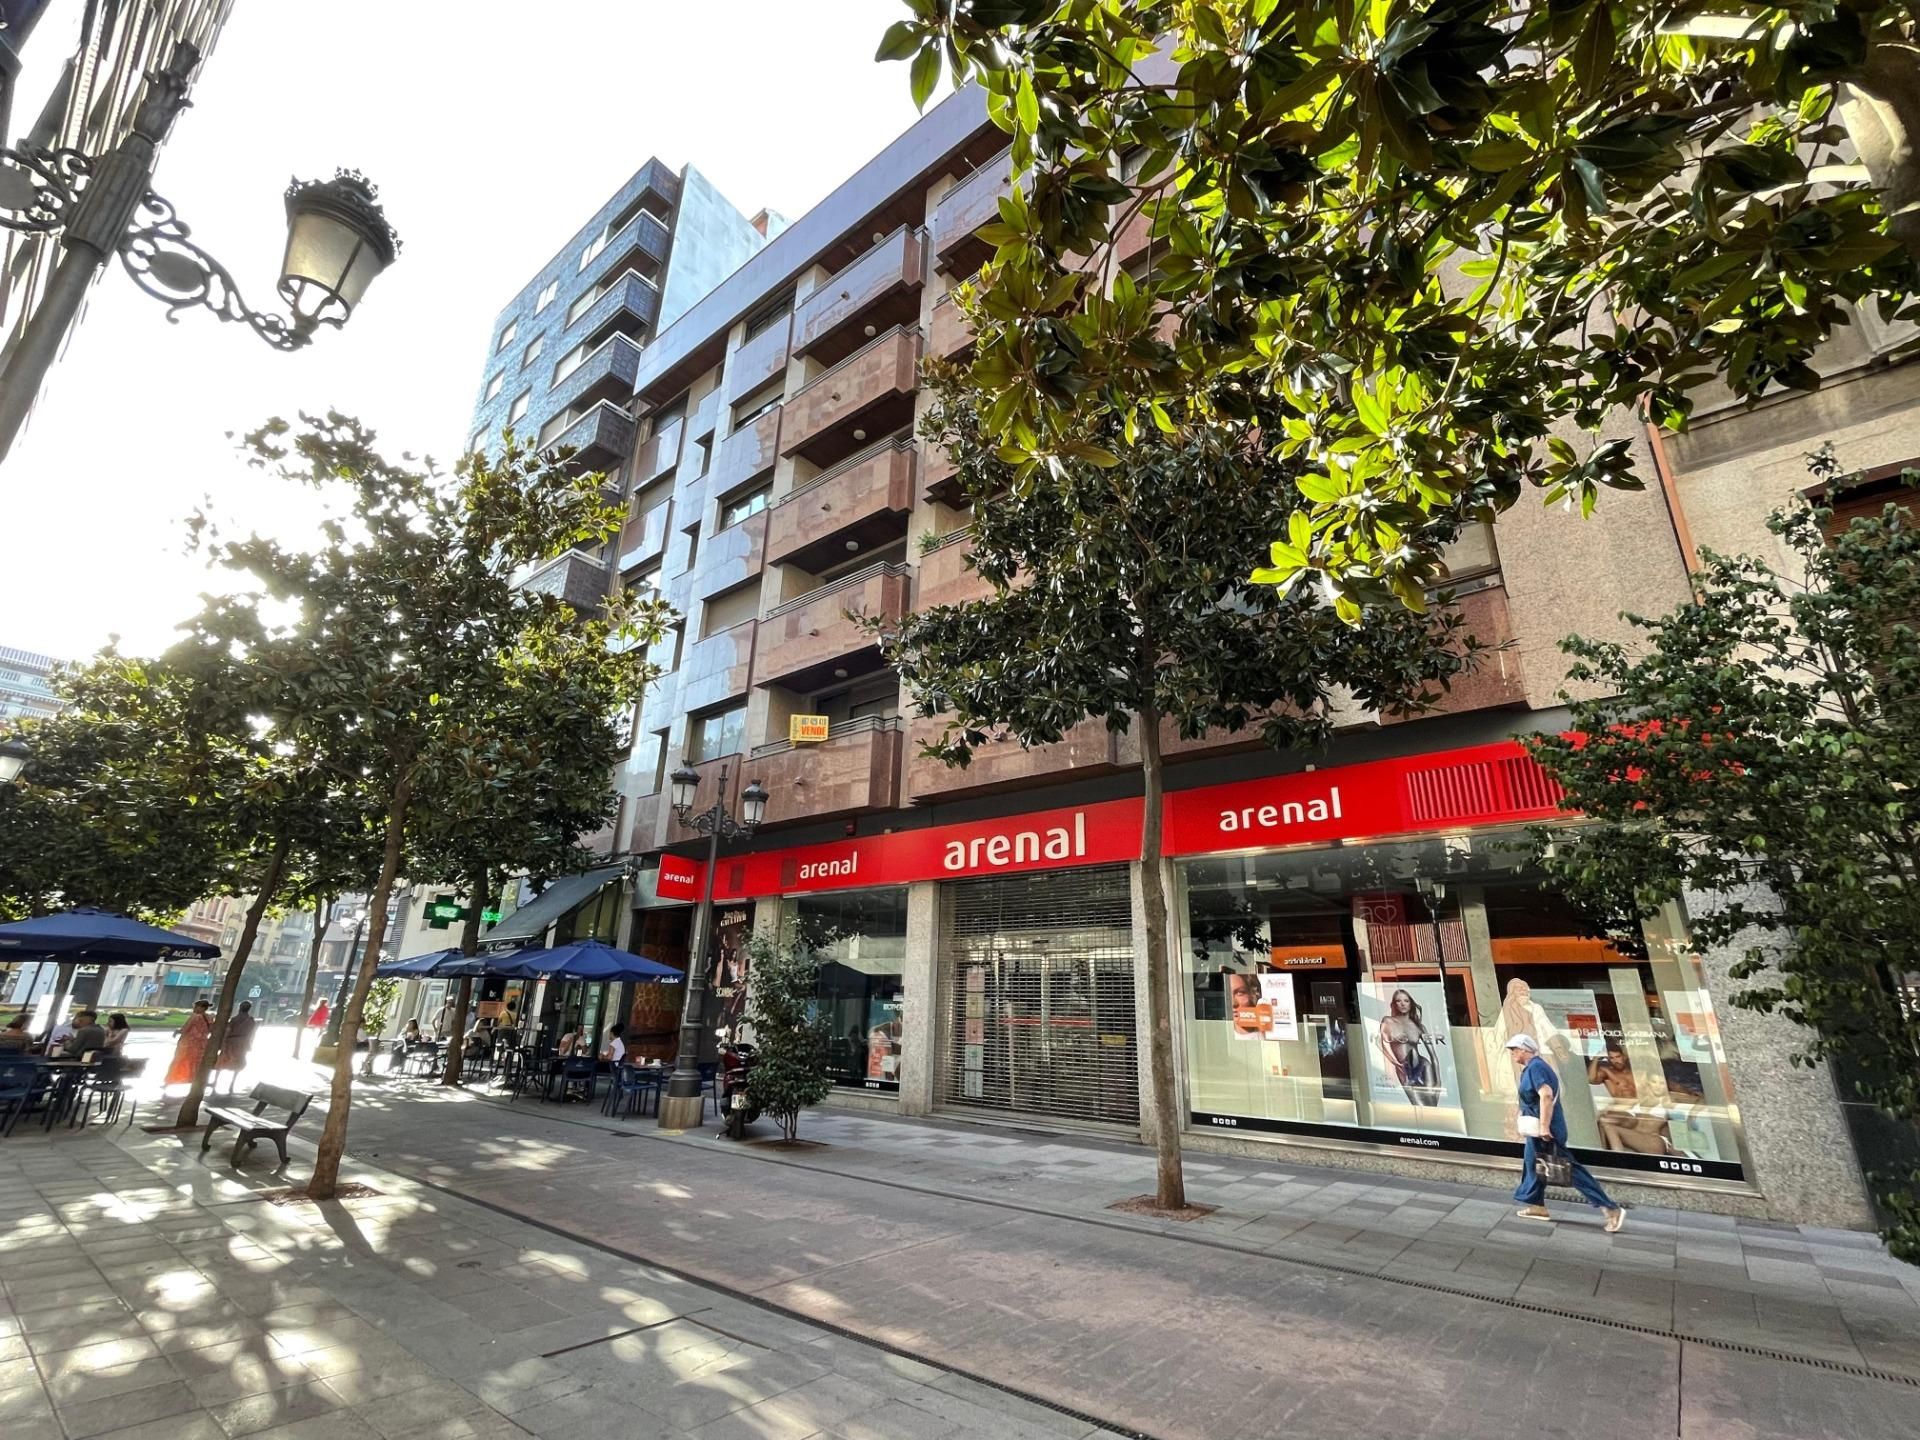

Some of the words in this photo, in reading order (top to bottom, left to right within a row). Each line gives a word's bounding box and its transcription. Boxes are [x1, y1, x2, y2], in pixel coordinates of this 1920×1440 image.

[801, 726, 827, 736] VENDE
[1219, 787, 1342, 832] arenal
[943, 812, 1086, 874] arenal
[799, 851, 858, 879] arenal
[664, 873, 694, 884] arenal
[1399, 1136, 1440, 1148] arenal.com
